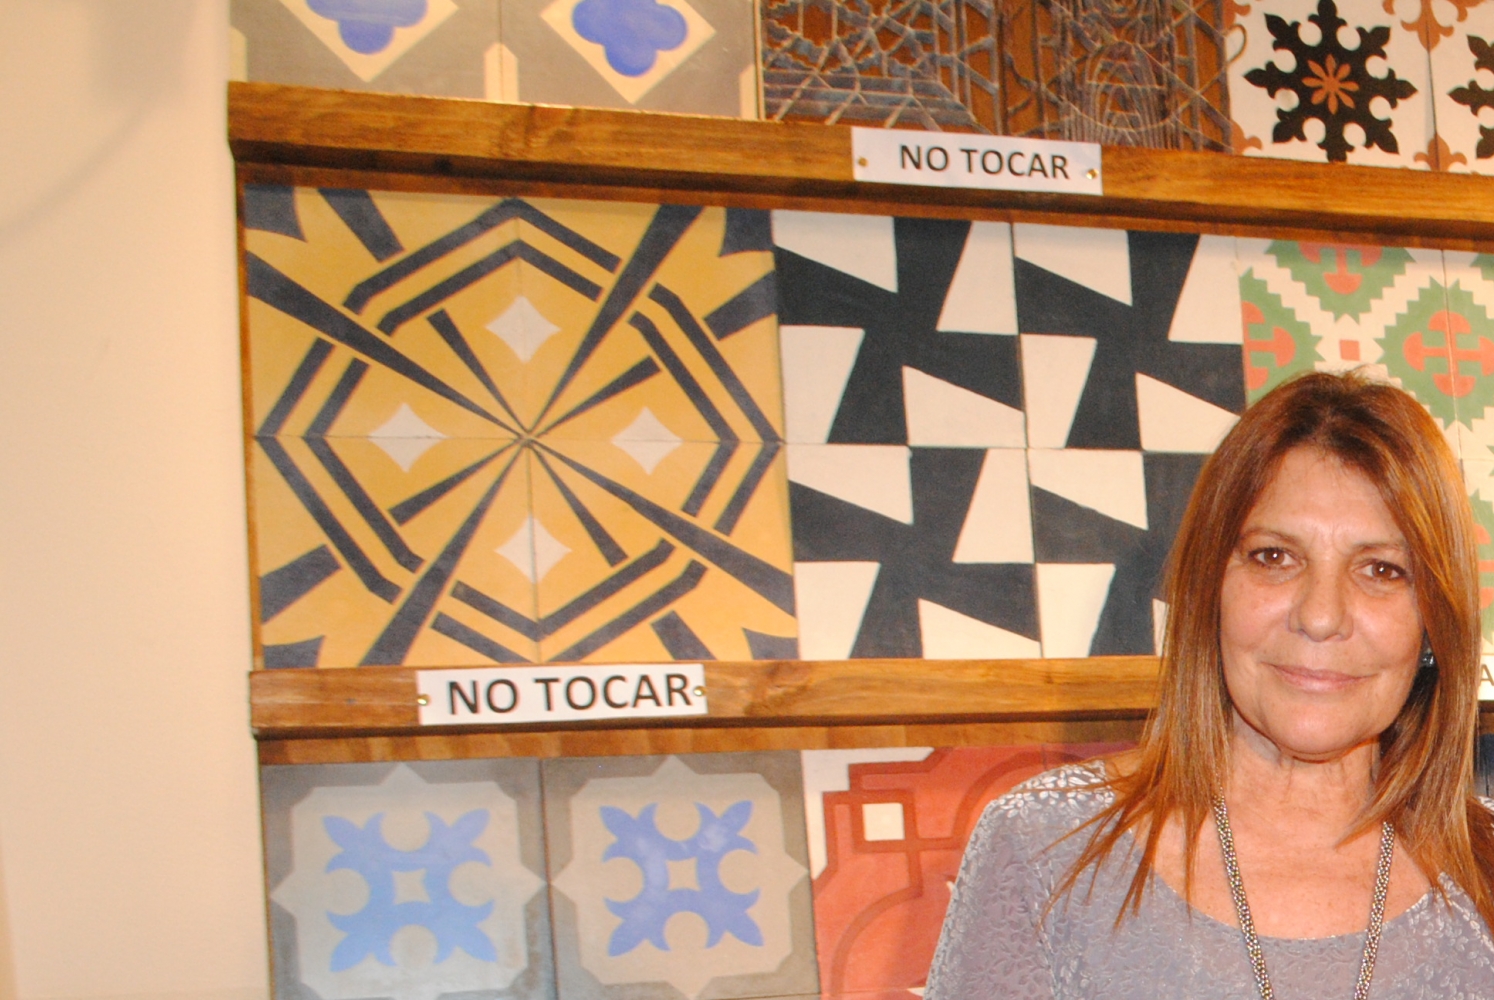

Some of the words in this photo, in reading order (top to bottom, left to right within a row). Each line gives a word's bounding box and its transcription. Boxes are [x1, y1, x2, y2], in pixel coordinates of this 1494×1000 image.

[899, 144, 949, 172] NO
[960, 148, 1070, 180] TOCAR
[448, 678, 519, 715] NO
[534, 673, 693, 712] TOCAR
